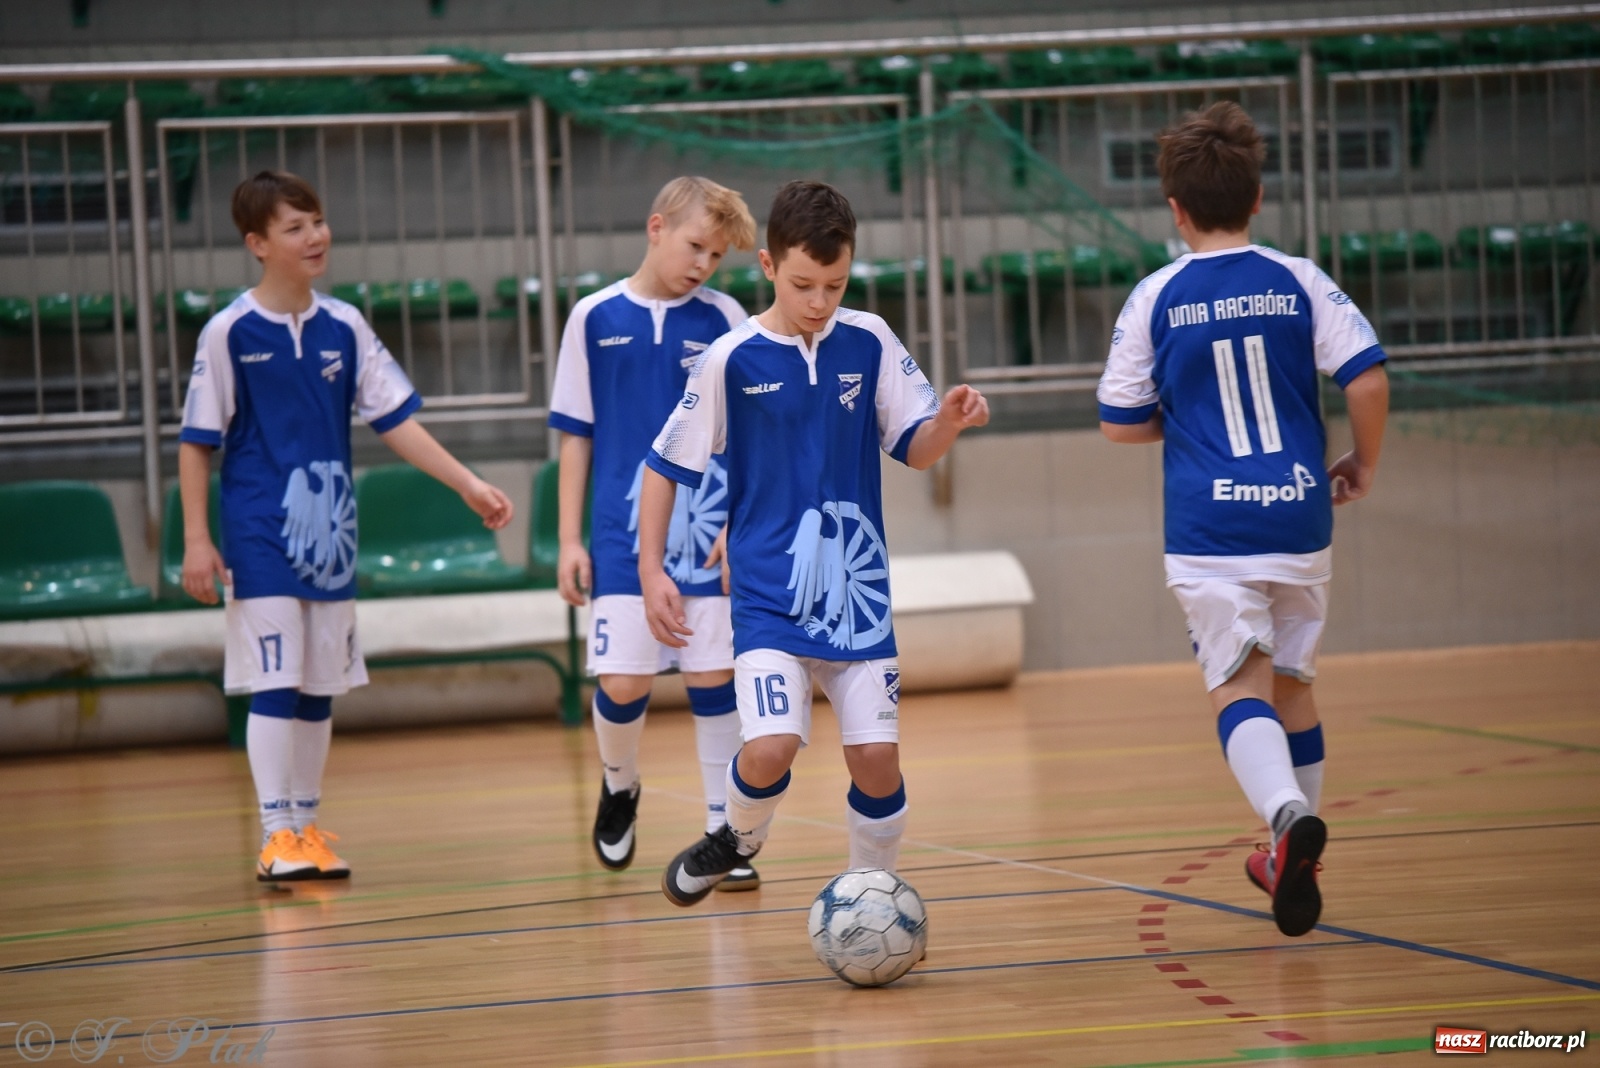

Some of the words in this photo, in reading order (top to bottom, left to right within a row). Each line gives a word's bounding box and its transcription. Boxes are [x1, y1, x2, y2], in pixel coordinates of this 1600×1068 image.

[1167, 302, 1209, 328] UNIA
[1214, 288, 1299, 320] RACIBÓRZ
[1212, 335, 1283, 457] 11
[259, 633, 282, 673] 17
[594, 619, 608, 655] 5
[754, 674, 789, 717] 16
